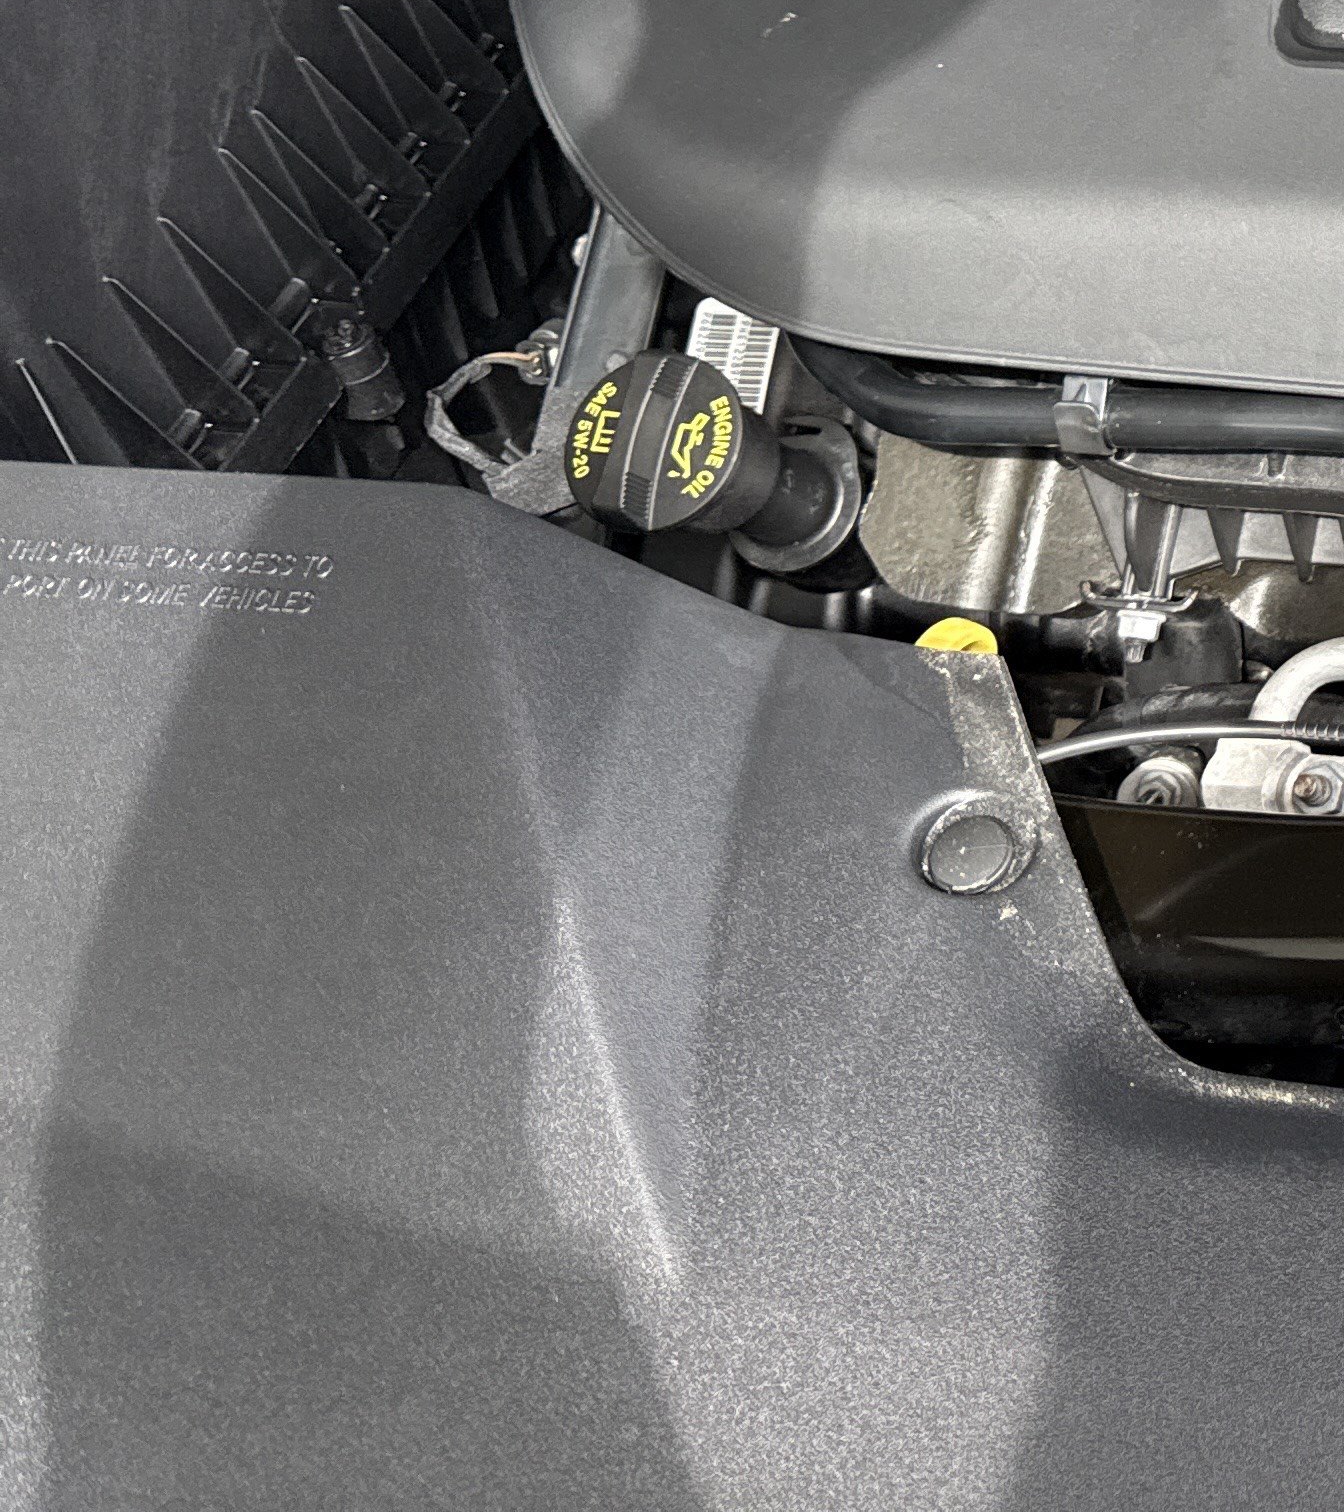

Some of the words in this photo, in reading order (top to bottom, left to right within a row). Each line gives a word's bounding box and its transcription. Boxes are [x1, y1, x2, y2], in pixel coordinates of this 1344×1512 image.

[584, 381, 618, 417] SAE
[572, 419, 594, 479] 5W-20
[705, 395, 733, 469] ENGINE
[681, 469, 715, 499] OIL
[8, 538, 62, 563] THIS
[146, 546, 198, 570] FOR
[198, 551, 298, 576] ACCESS
[303, 555, 334, 579] TO
[2, 574, 71, 600] PORT
[77, 576, 116, 601] ON
[117, 580, 190, 606] SOME
[199, 586, 315, 613] VEHICLES
